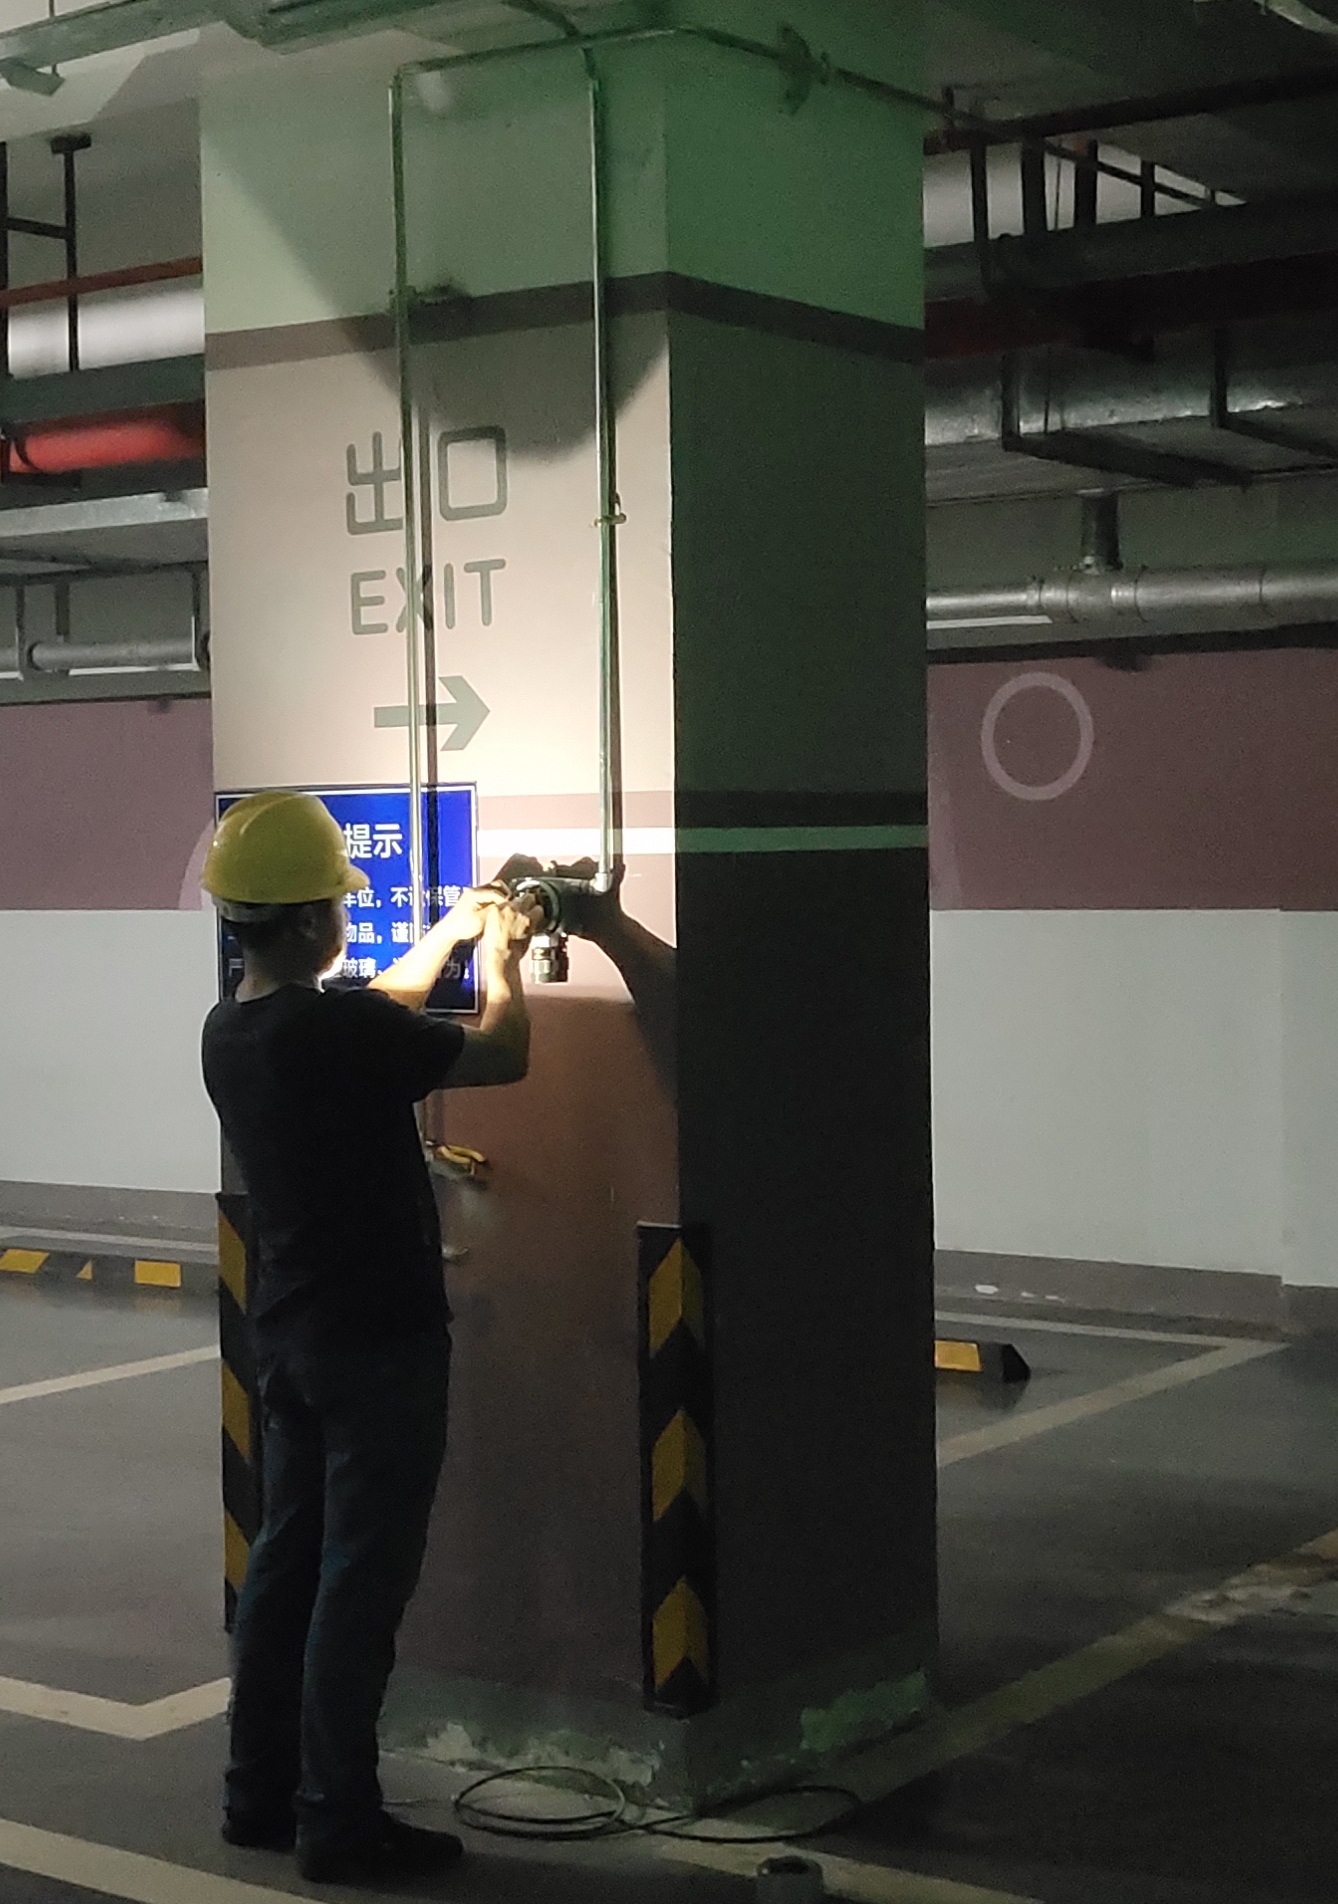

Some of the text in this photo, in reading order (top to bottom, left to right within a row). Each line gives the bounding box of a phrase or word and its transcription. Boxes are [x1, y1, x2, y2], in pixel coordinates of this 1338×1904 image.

[346, 426, 507, 535] 出口
[351, 559, 506, 635] EXIT
[343, 822, 403, 859] 提示
